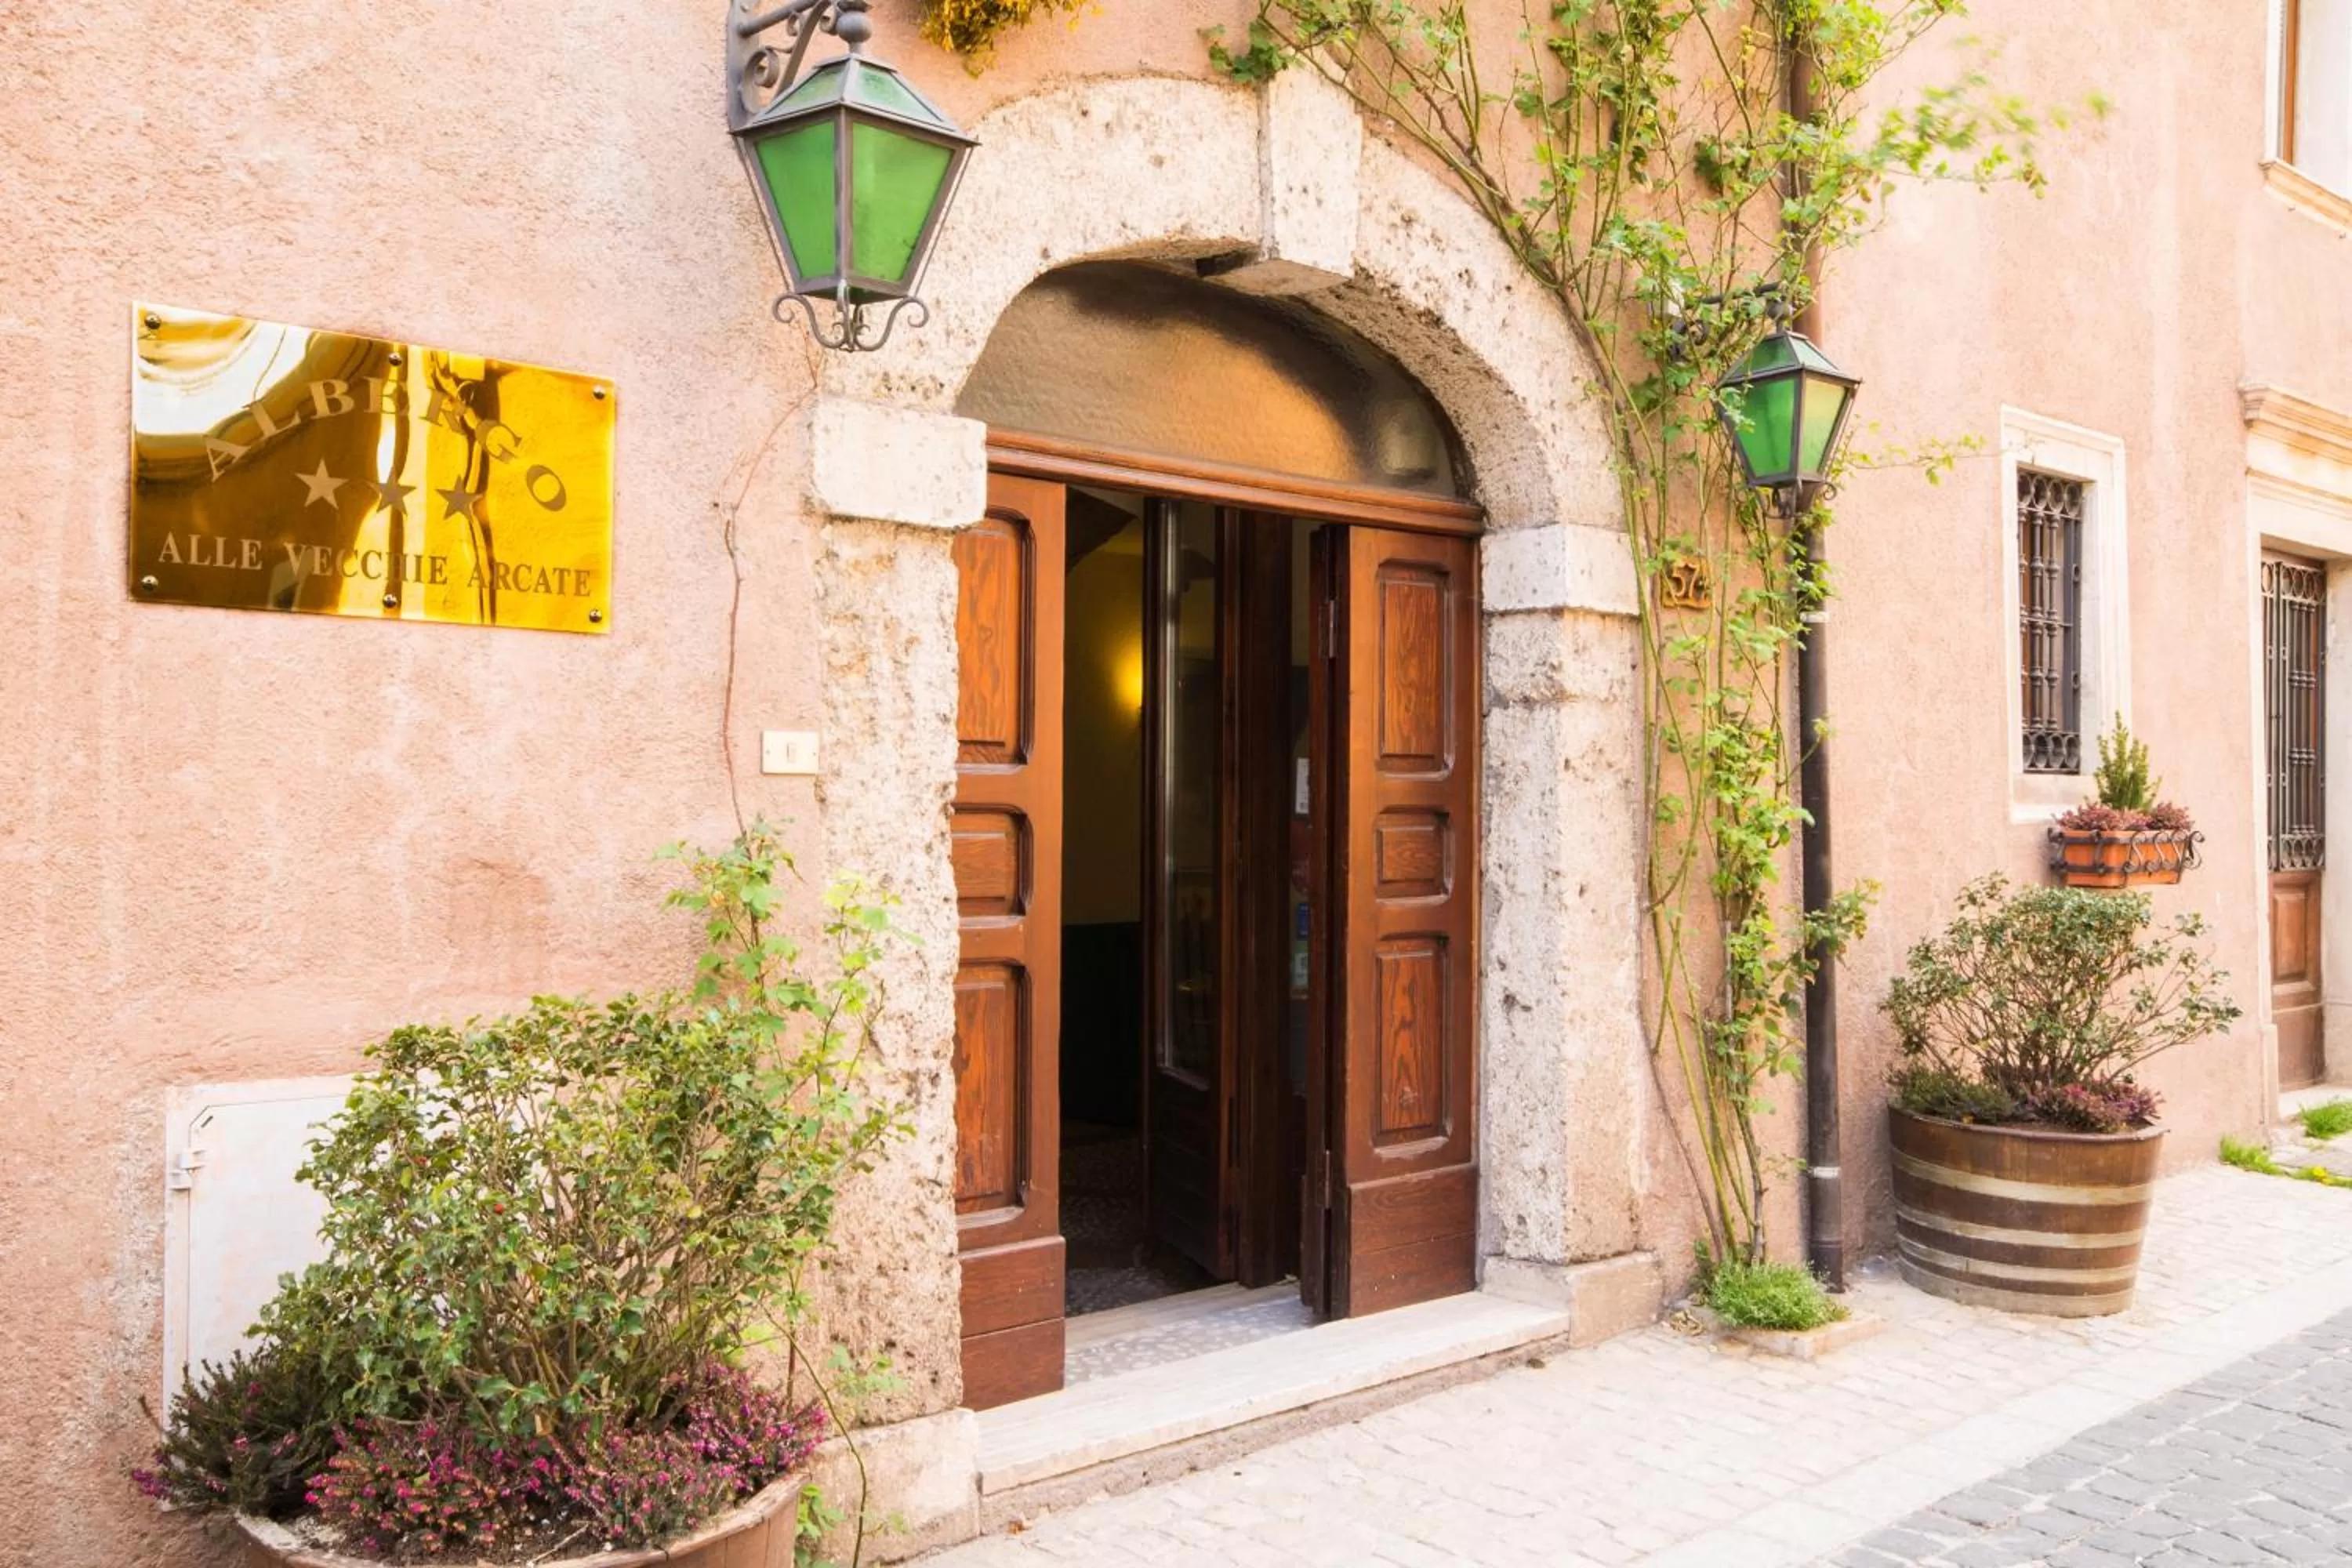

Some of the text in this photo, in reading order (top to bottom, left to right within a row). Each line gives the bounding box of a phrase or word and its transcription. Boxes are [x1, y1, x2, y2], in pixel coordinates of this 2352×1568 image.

[202, 377, 567, 511] ALBERGO
[158, 532, 590, 597] ALLE VECCHIE ARCATE
